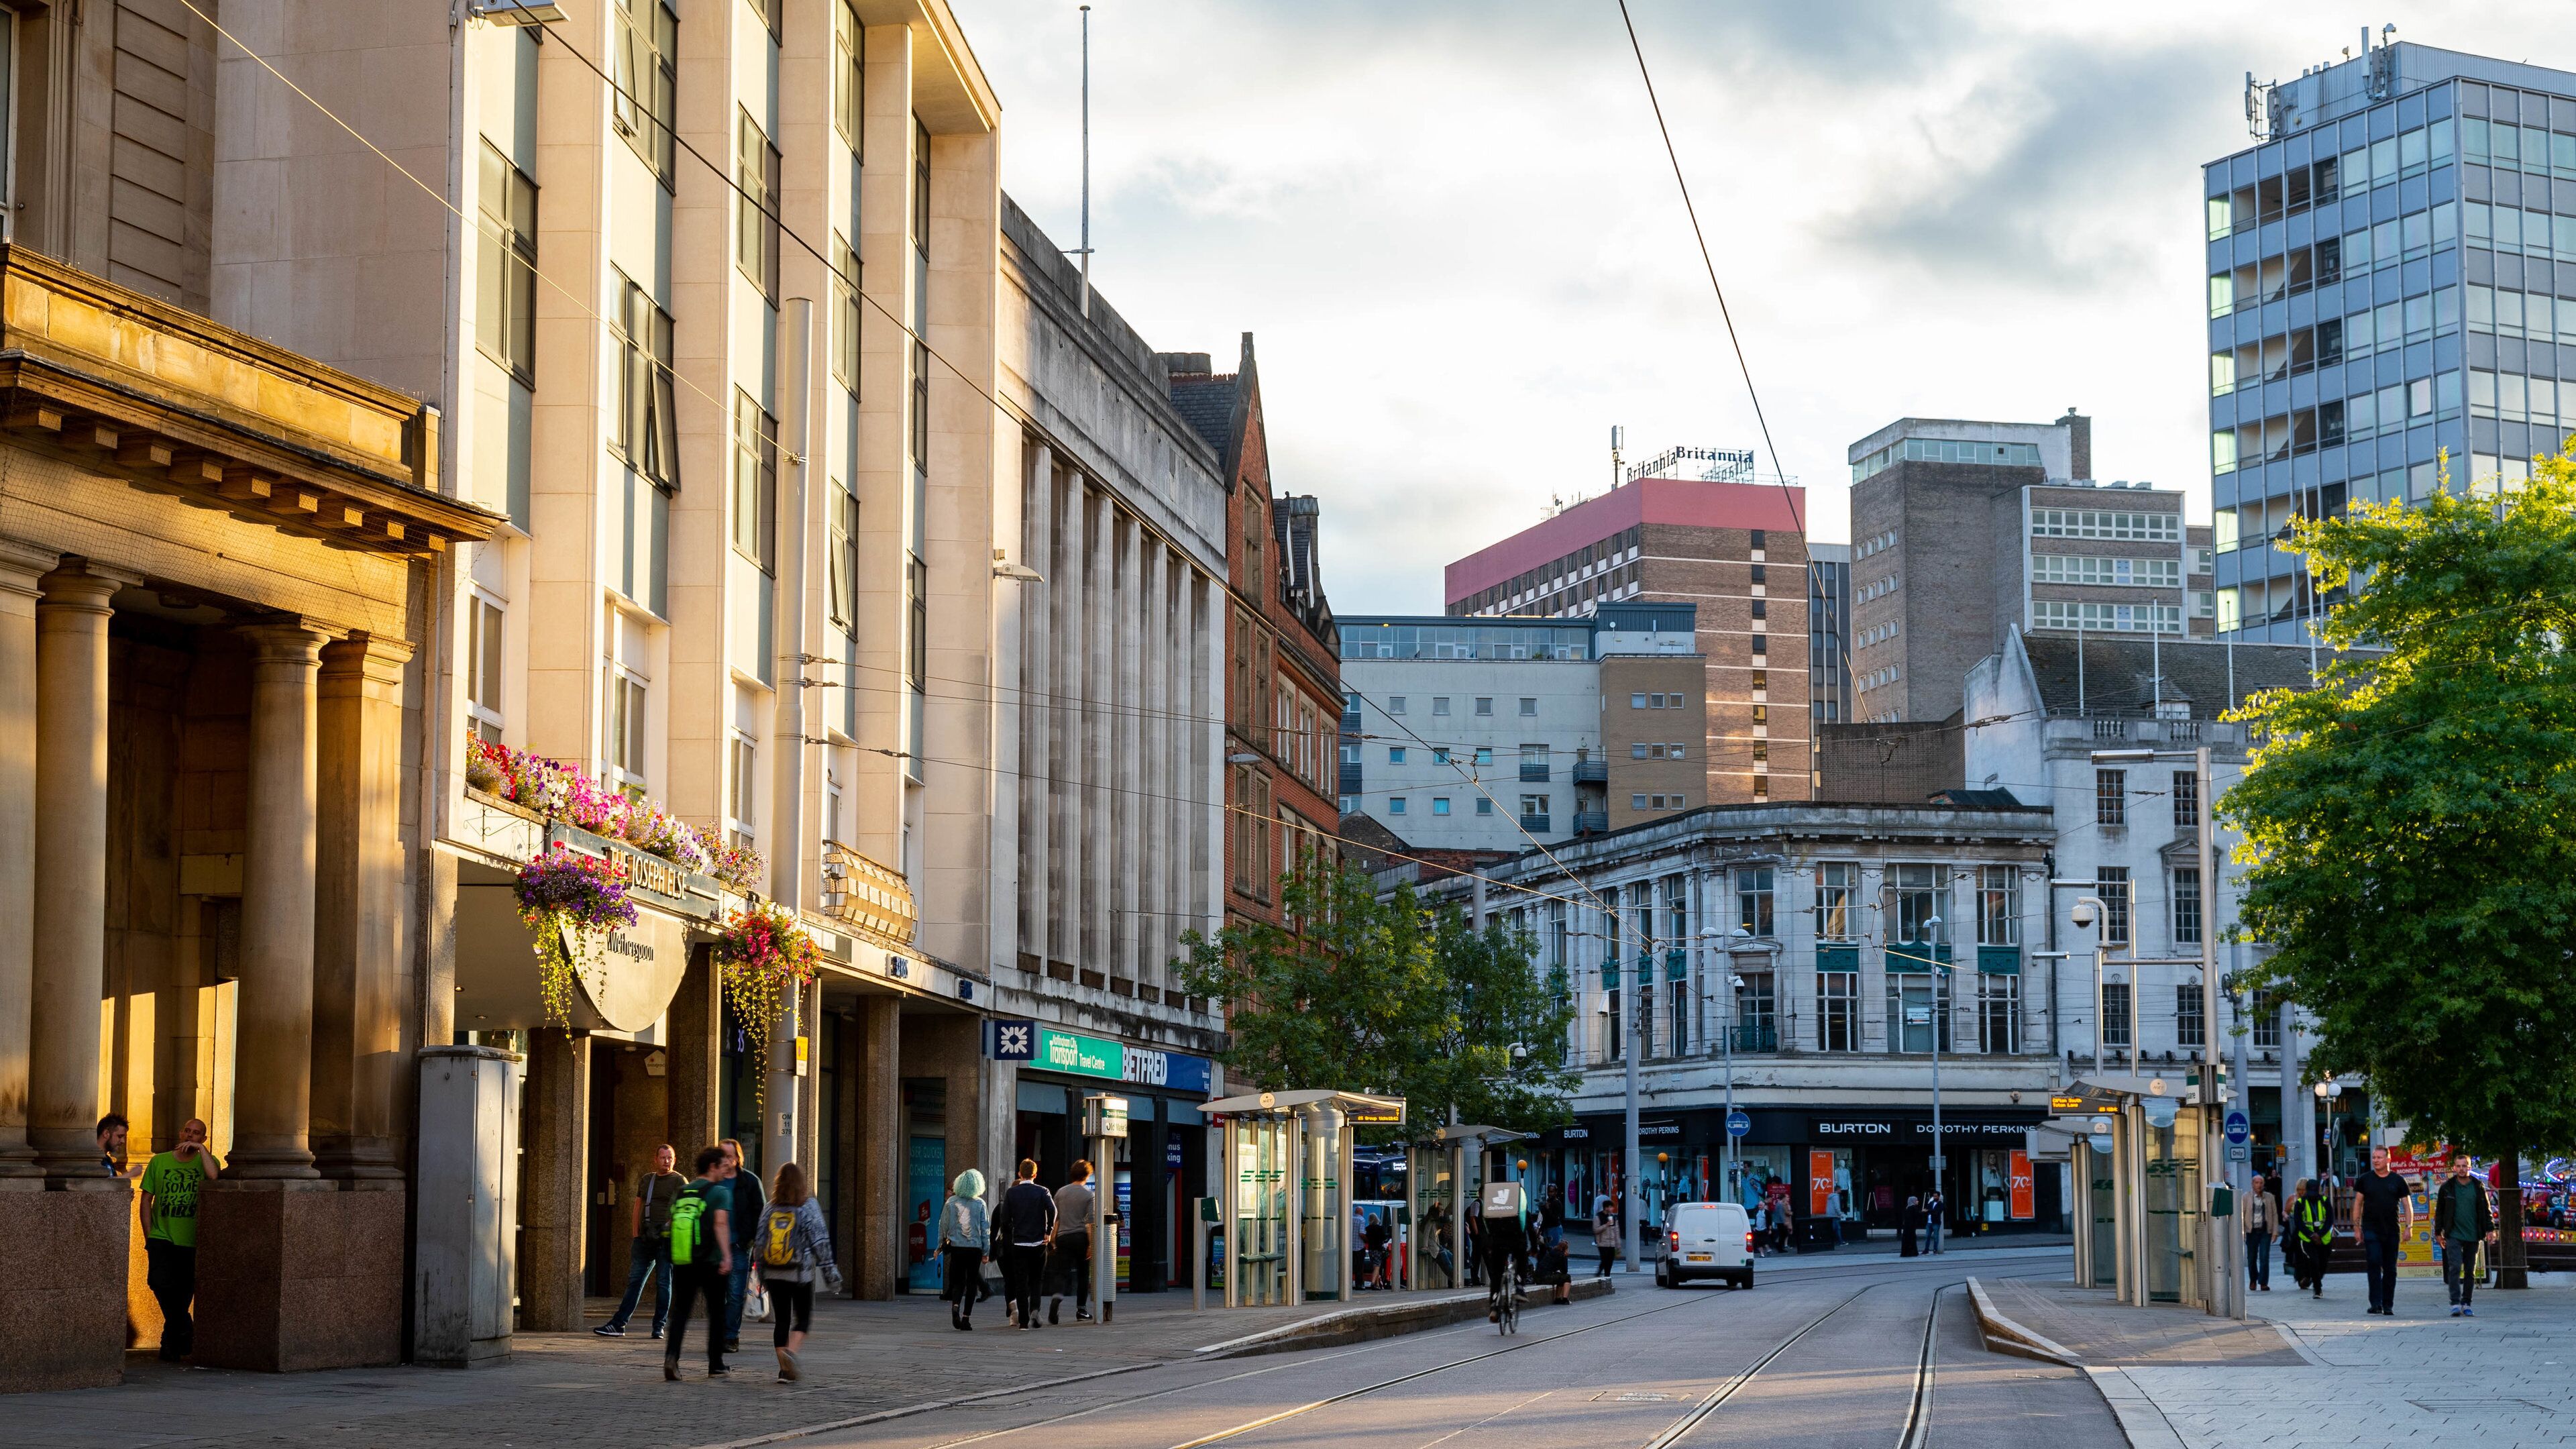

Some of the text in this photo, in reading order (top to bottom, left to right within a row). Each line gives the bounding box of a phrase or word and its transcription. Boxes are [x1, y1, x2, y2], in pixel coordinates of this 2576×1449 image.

[1676, 446, 1754, 462] Britannia
[610, 847, 687, 900] THE JOSEPH ELSE
[607, 930, 654, 963] Wetherspoon
[1049, 1040, 1106, 1071] Transport Travel Centre
[1122, 1046, 1167, 1085] BETFRED
[1564, 1129, 1588, 1138] BURTON
[1638, 1126, 1680, 1135] OROTHY PERKINS
[1819, 1124, 1891, 1134] BURTON
[1917, 1125, 2037, 1134] DOROTHY PERKINS
